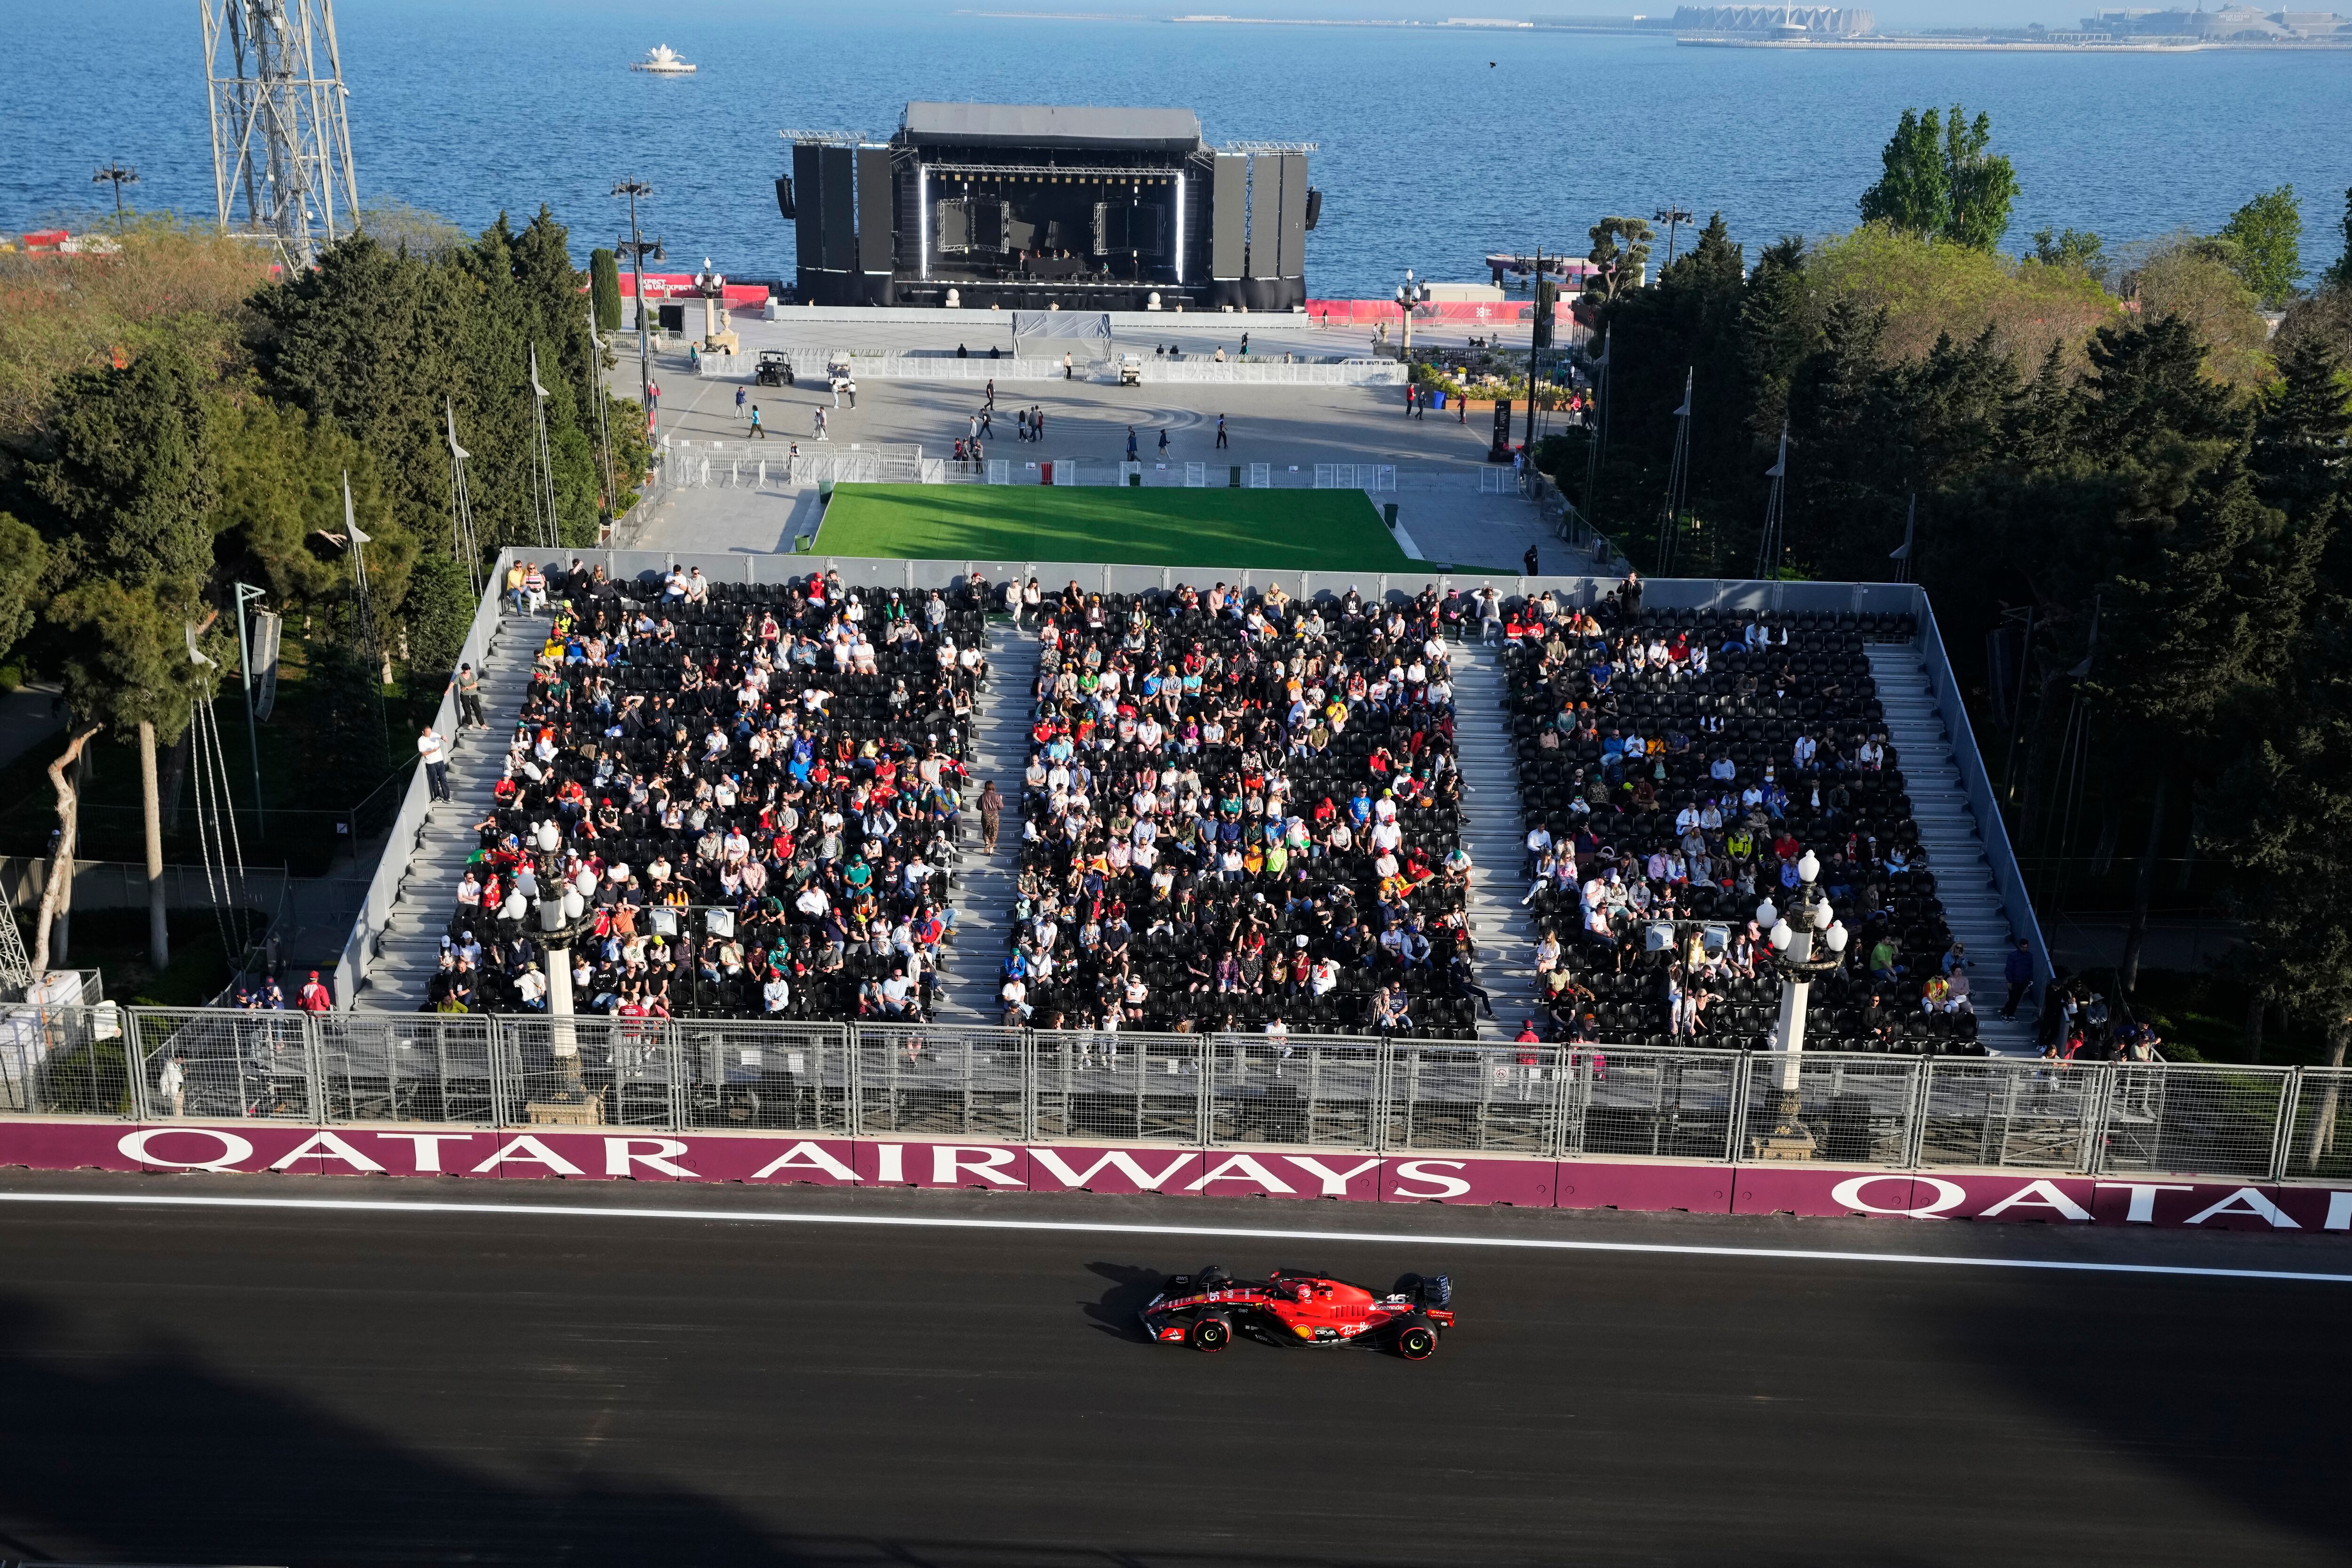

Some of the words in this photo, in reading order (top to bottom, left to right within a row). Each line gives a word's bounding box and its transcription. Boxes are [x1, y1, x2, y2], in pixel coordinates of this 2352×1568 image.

[1348, 601, 1356, 609] NY
[118, 1128, 701, 1178] QATAR
[751, 1141, 1470, 1202] AIRWAYS
[1209, 1291, 1220, 1302] 16
[1387, 1294, 1406, 1304] 16
[1340, 1321, 1373, 1336] Ray-Ban
